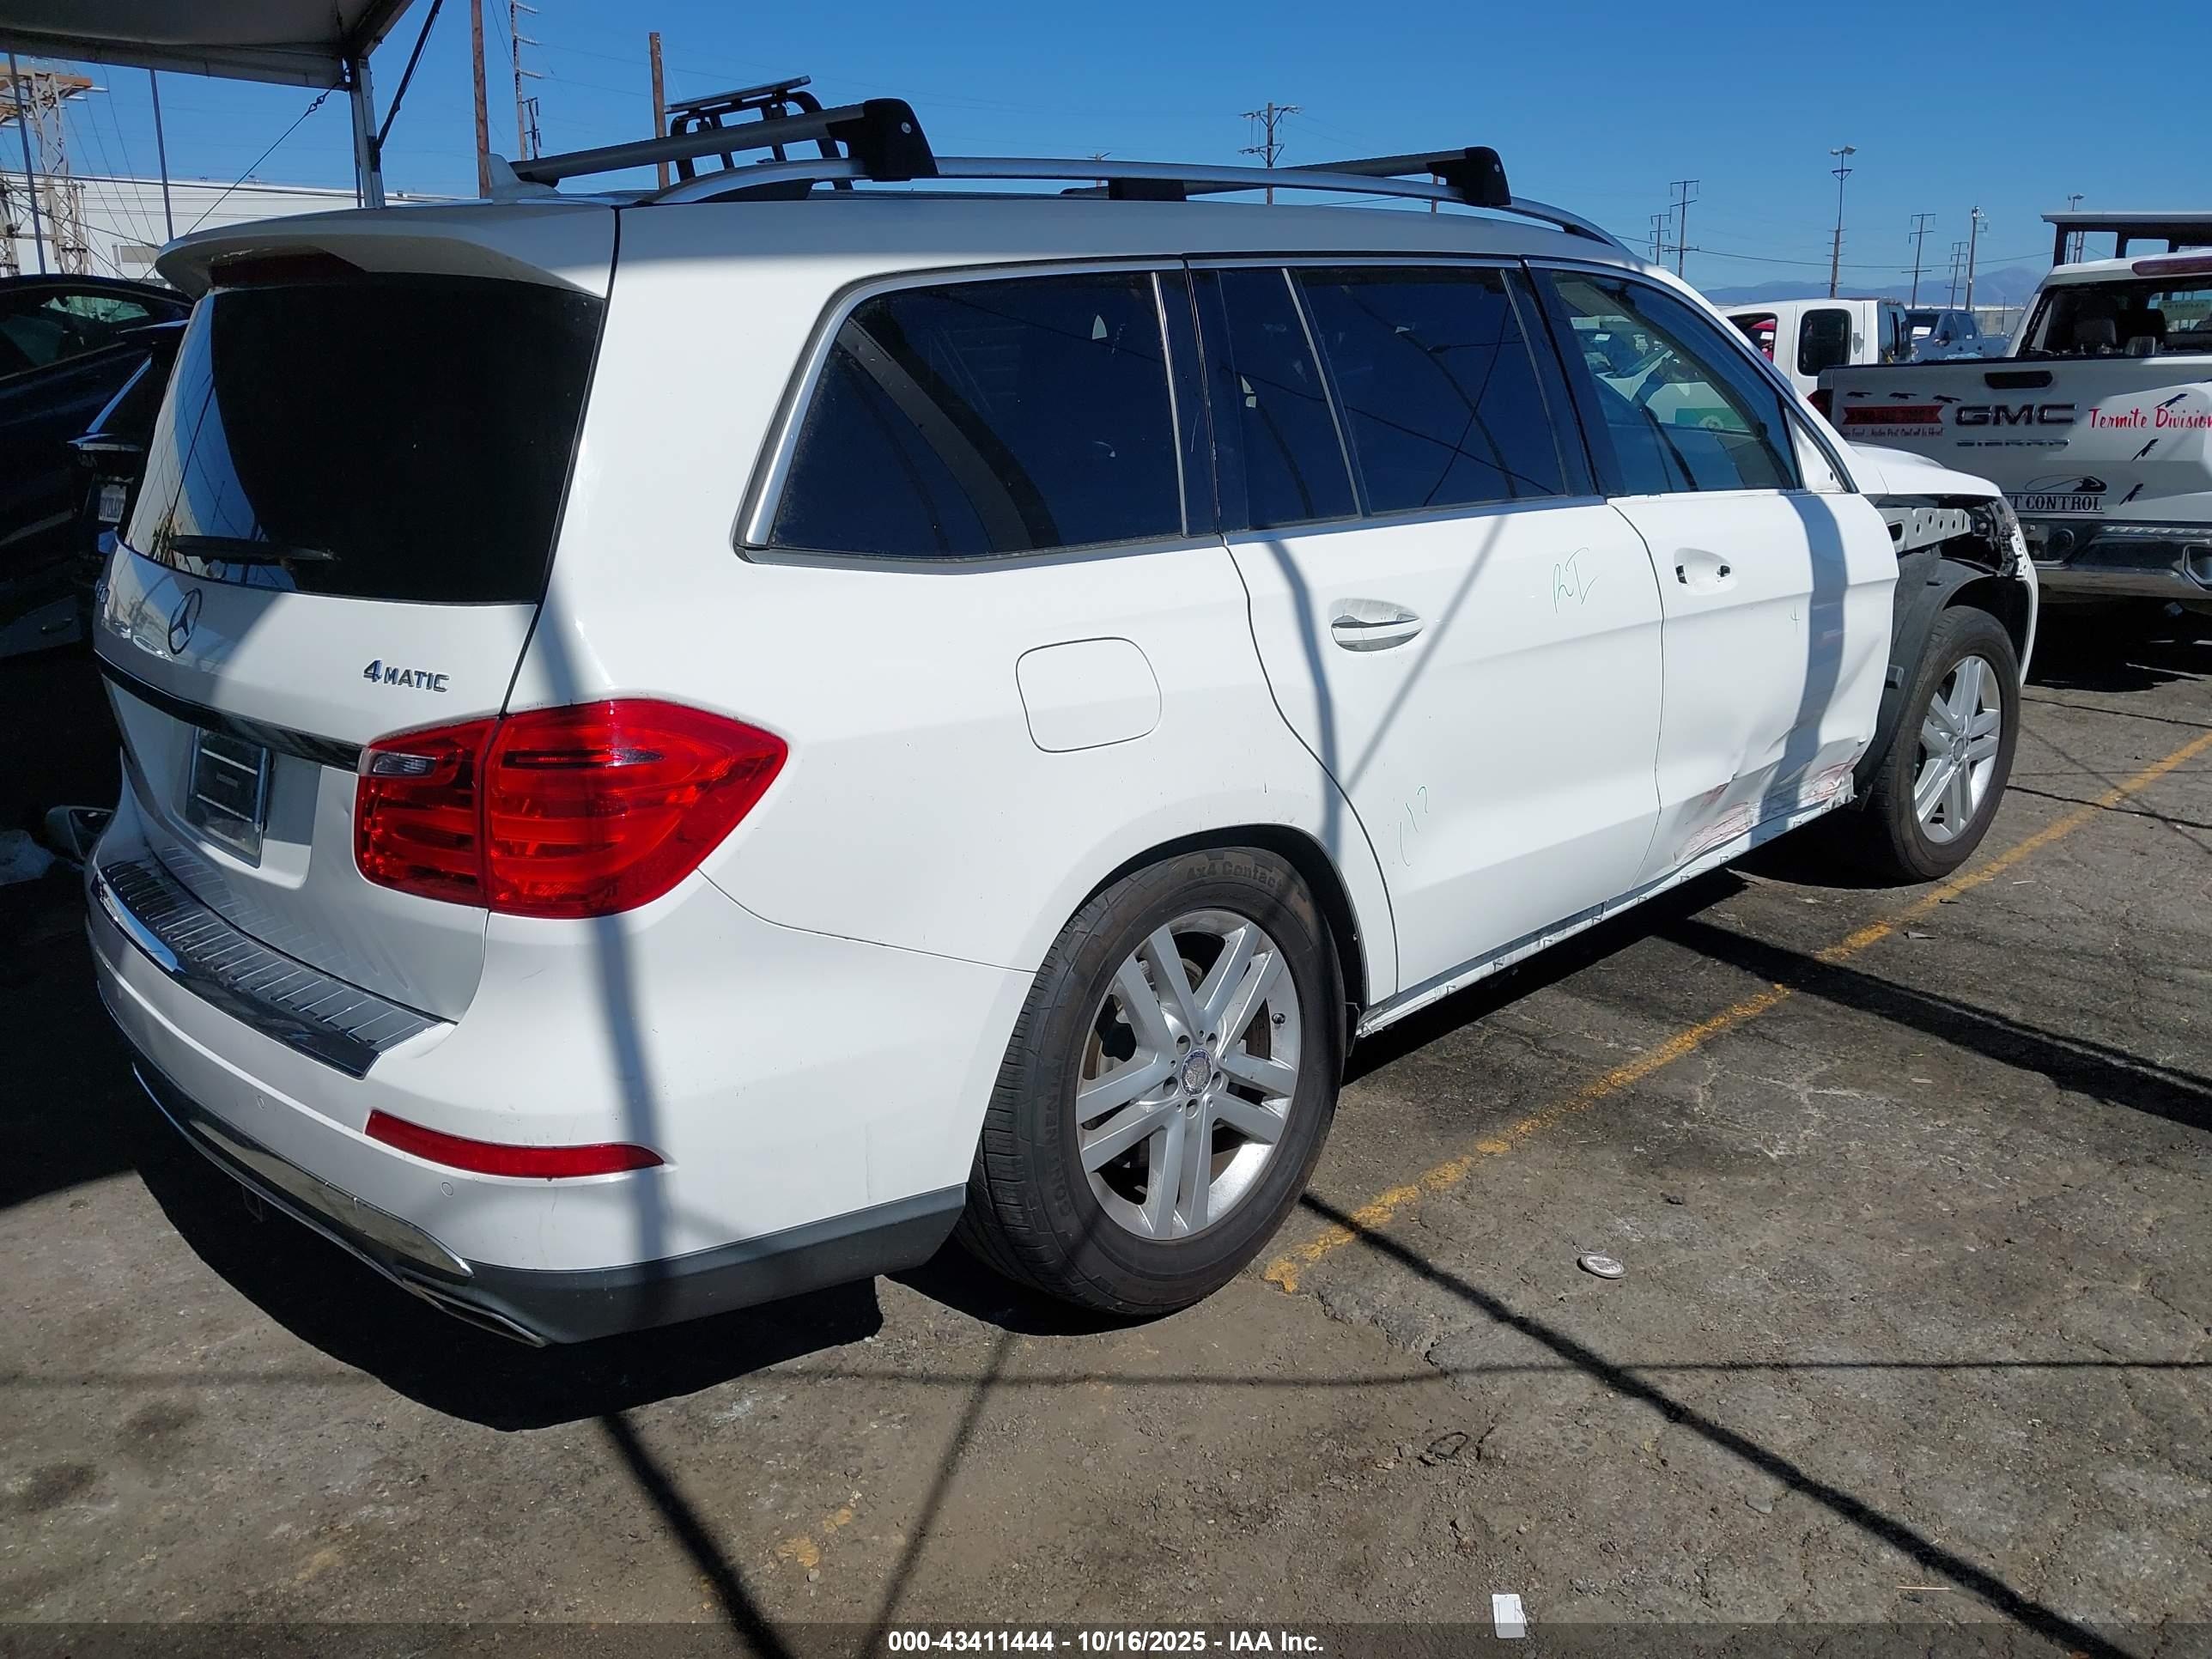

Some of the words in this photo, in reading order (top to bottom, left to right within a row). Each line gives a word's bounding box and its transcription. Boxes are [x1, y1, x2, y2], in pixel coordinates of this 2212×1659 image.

[1956, 404, 2078, 426] GMC
[2088, 408, 2148, 428] Termite
[2027, 495, 2103, 512] CONTROL
[363, 659, 450, 692] 4MATIC
